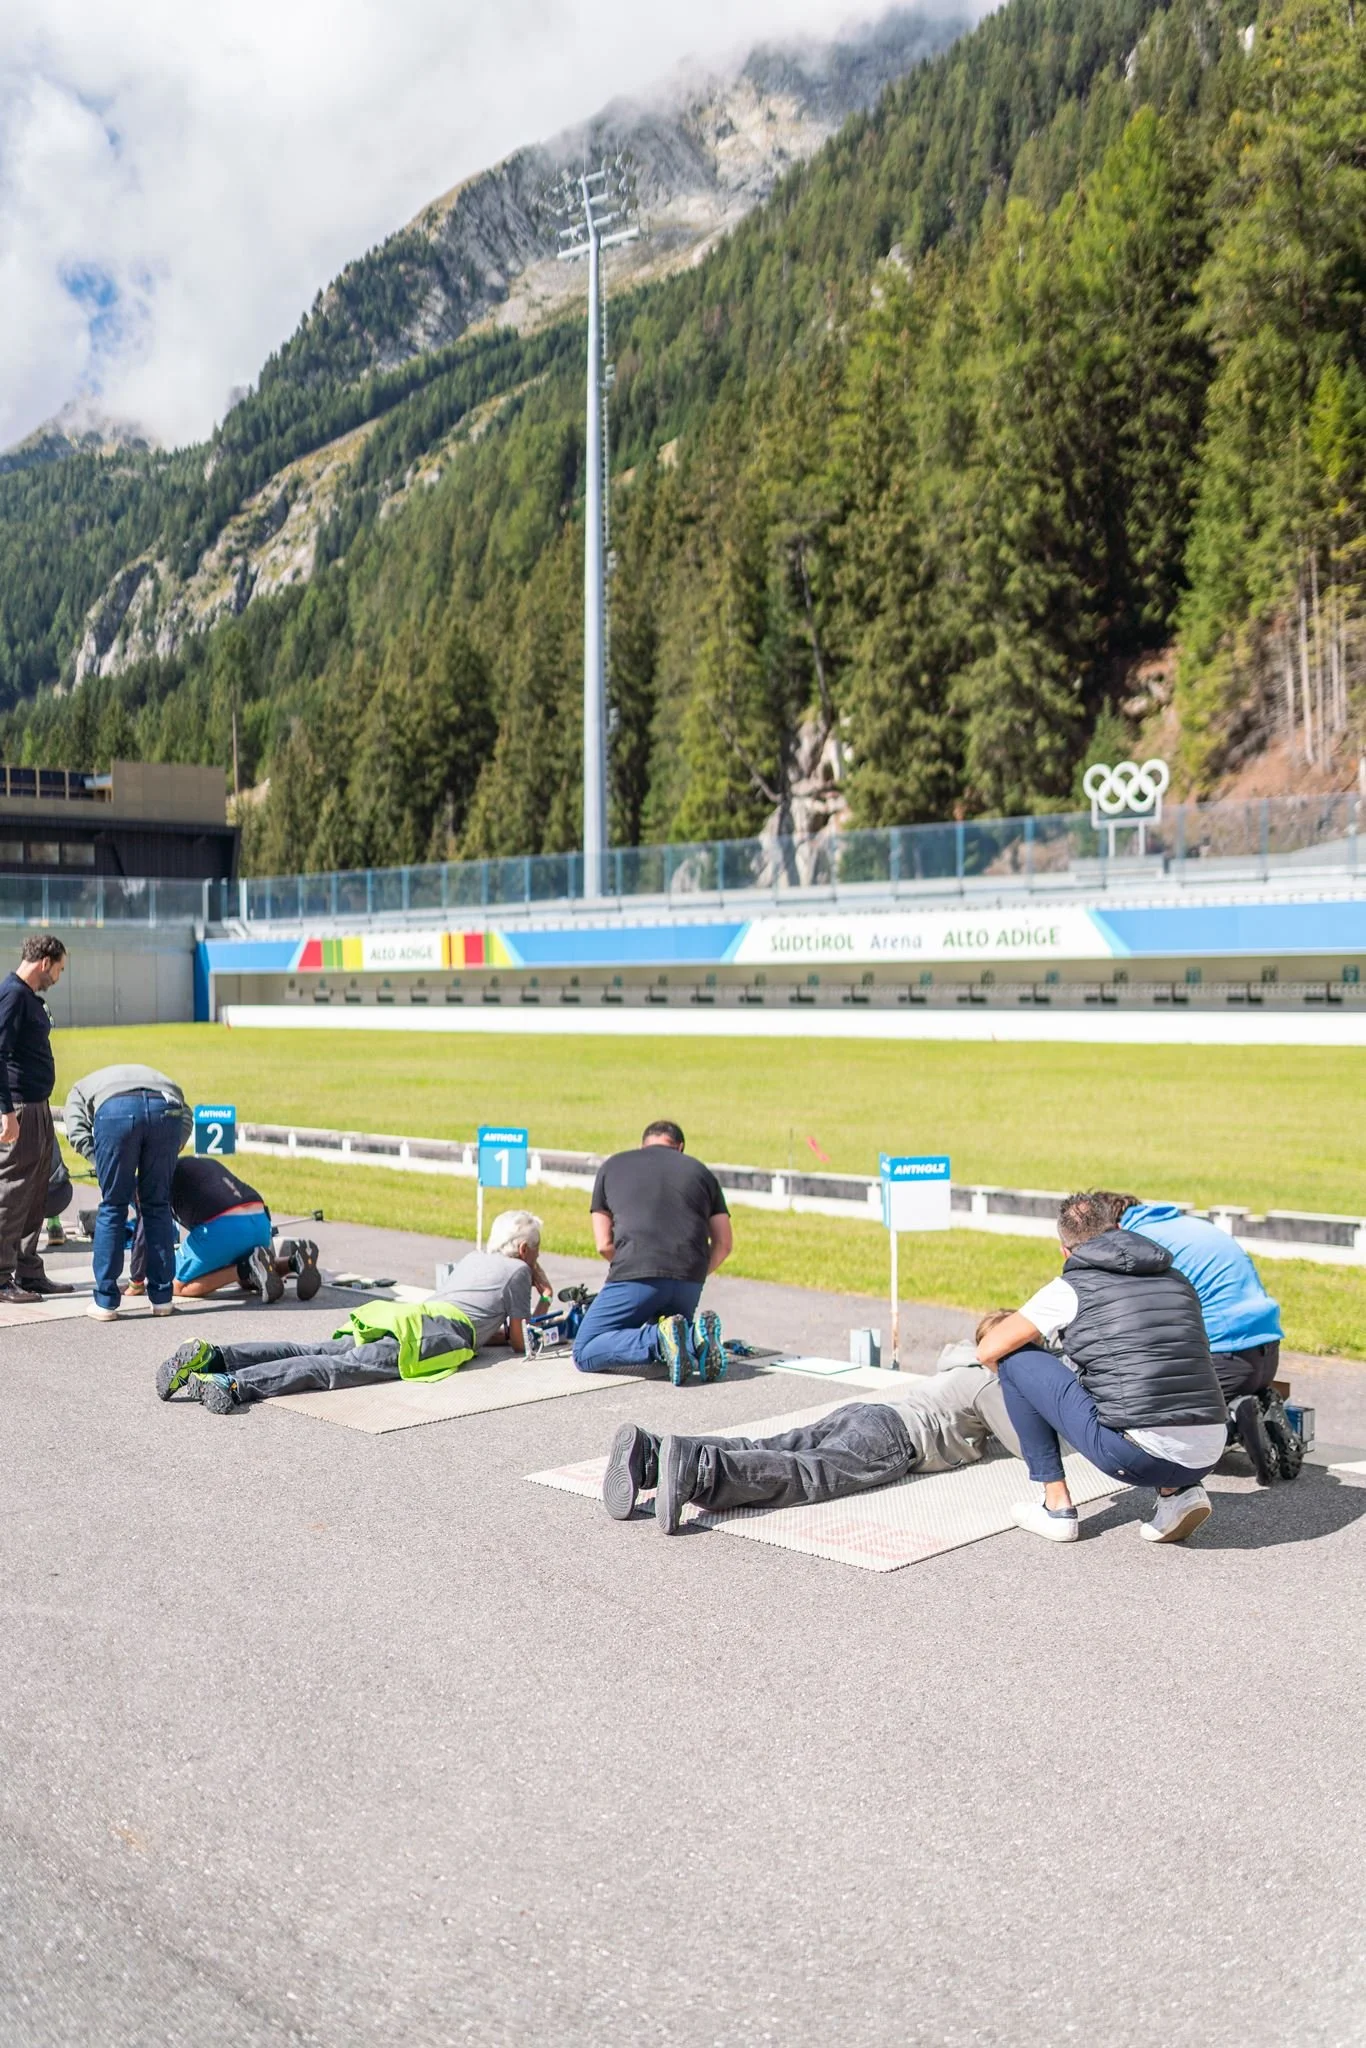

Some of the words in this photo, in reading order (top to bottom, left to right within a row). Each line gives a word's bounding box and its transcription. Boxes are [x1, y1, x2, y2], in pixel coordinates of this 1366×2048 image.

[870, 932, 922, 949] Arena
[943, 929, 989, 948] ALTO
[370, 946, 396, 961] ALTO
[206, 1122, 224, 1154] 2
[494, 1148, 509, 1186] 1
[892, 1162, 946, 1176] ANTHOLZ
